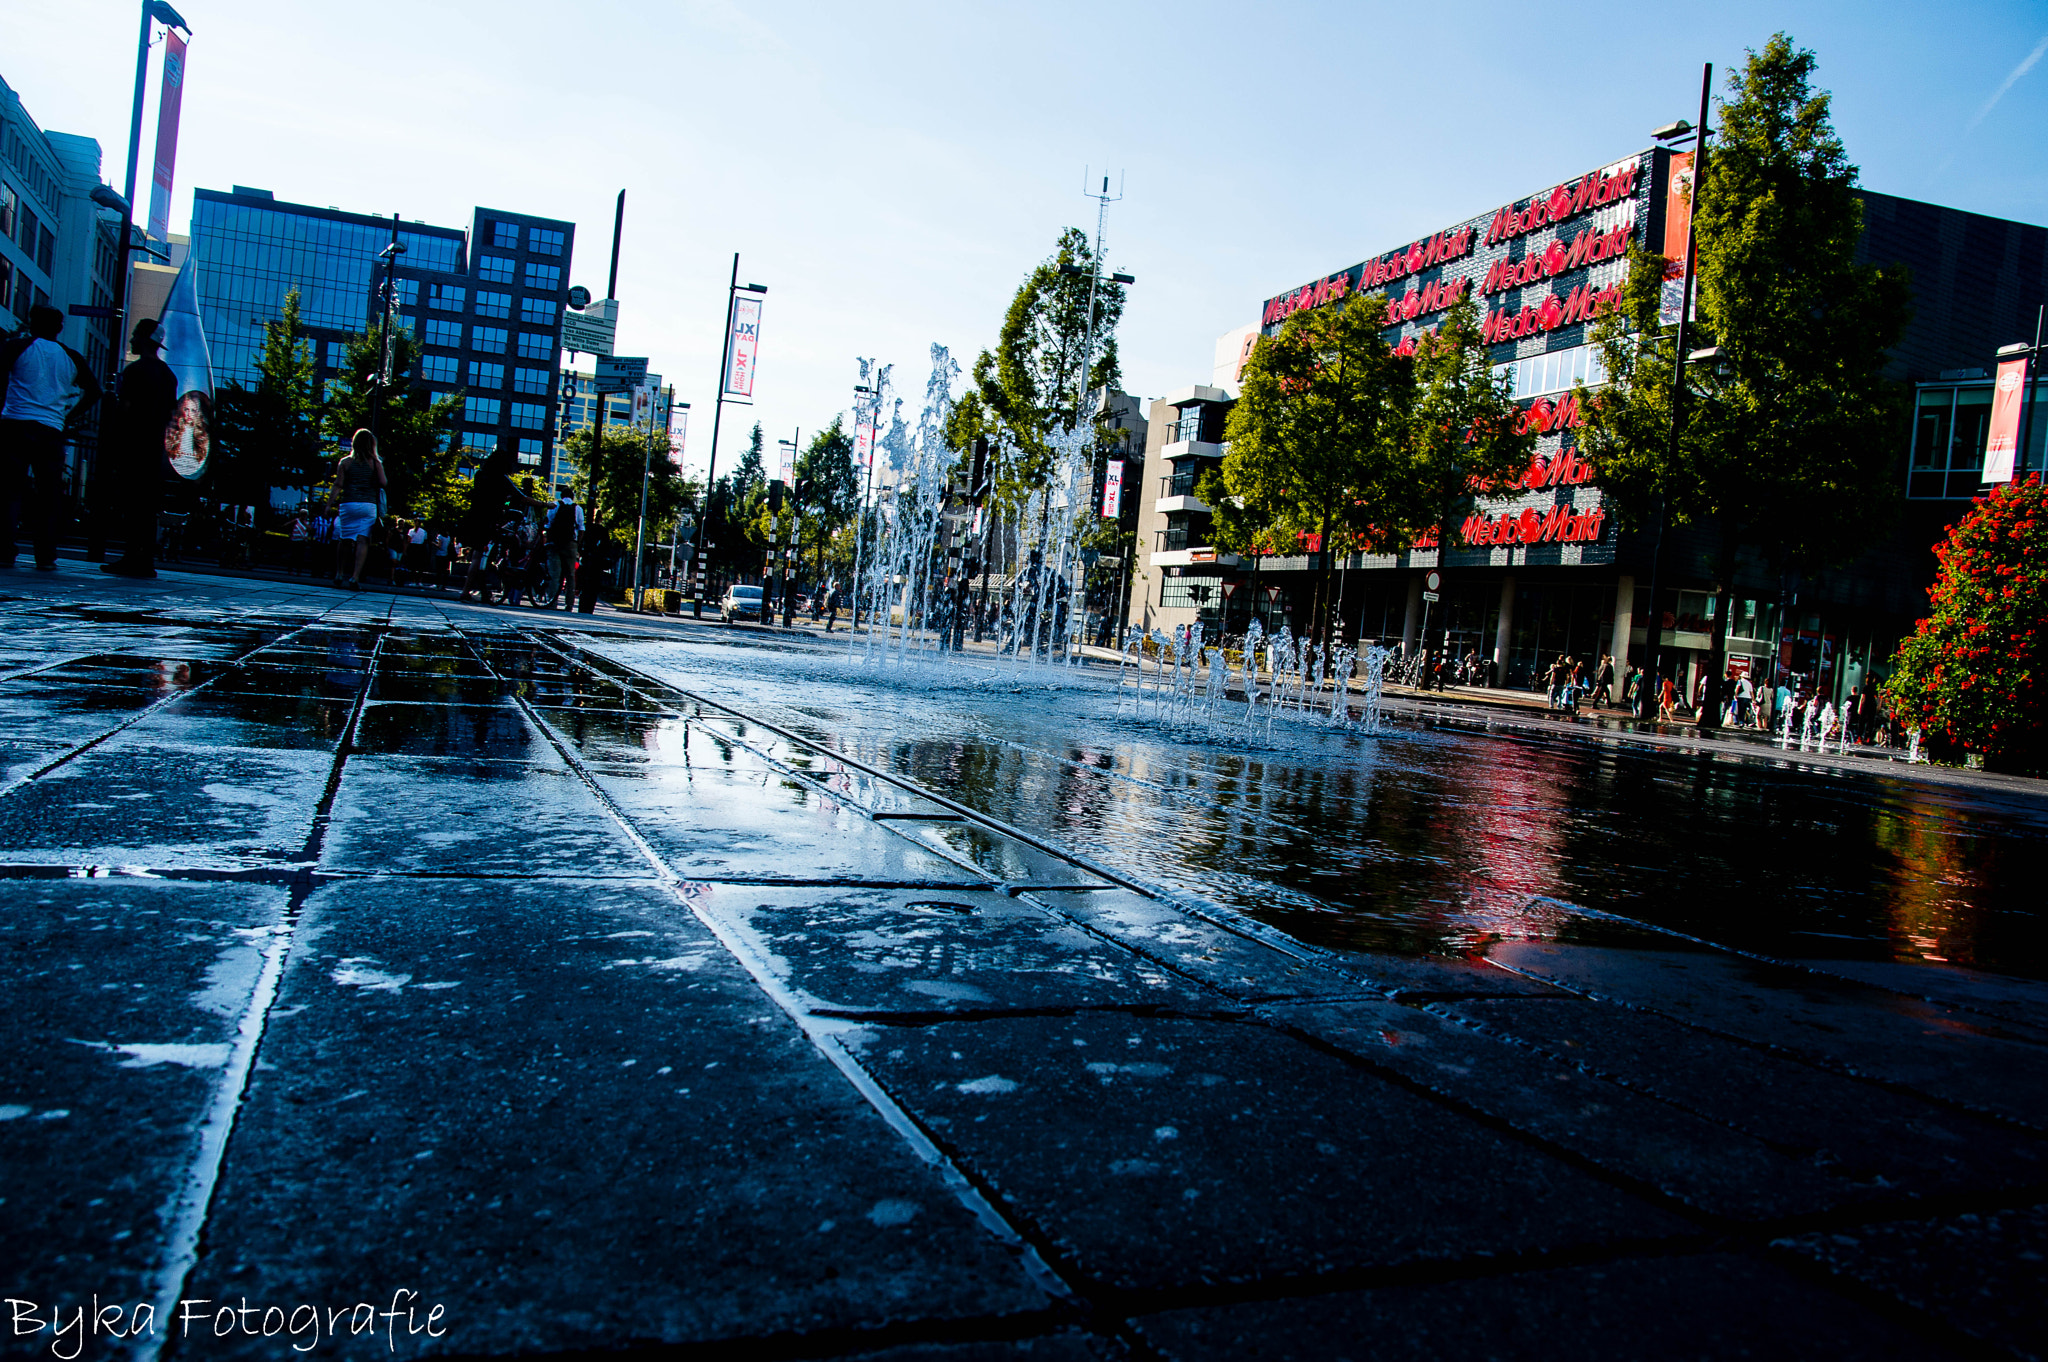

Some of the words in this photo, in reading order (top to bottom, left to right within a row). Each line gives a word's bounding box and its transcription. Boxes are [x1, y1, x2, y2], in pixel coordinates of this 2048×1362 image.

[1482, 198, 1549, 247] Media
[1565, 162, 1638, 217] Markt
[1356, 251, 1407, 292] Media
[1417, 225, 1472, 269] Markt
[1477, 252, 1544, 297] Media
[1559, 220, 1632, 271] Markt
[1261, 293, 1300, 327] Media
[1480, 305, 1540, 345] Media
[1460, 513, 1520, 545] Media
[1531, 504, 1605, 542] Markt
